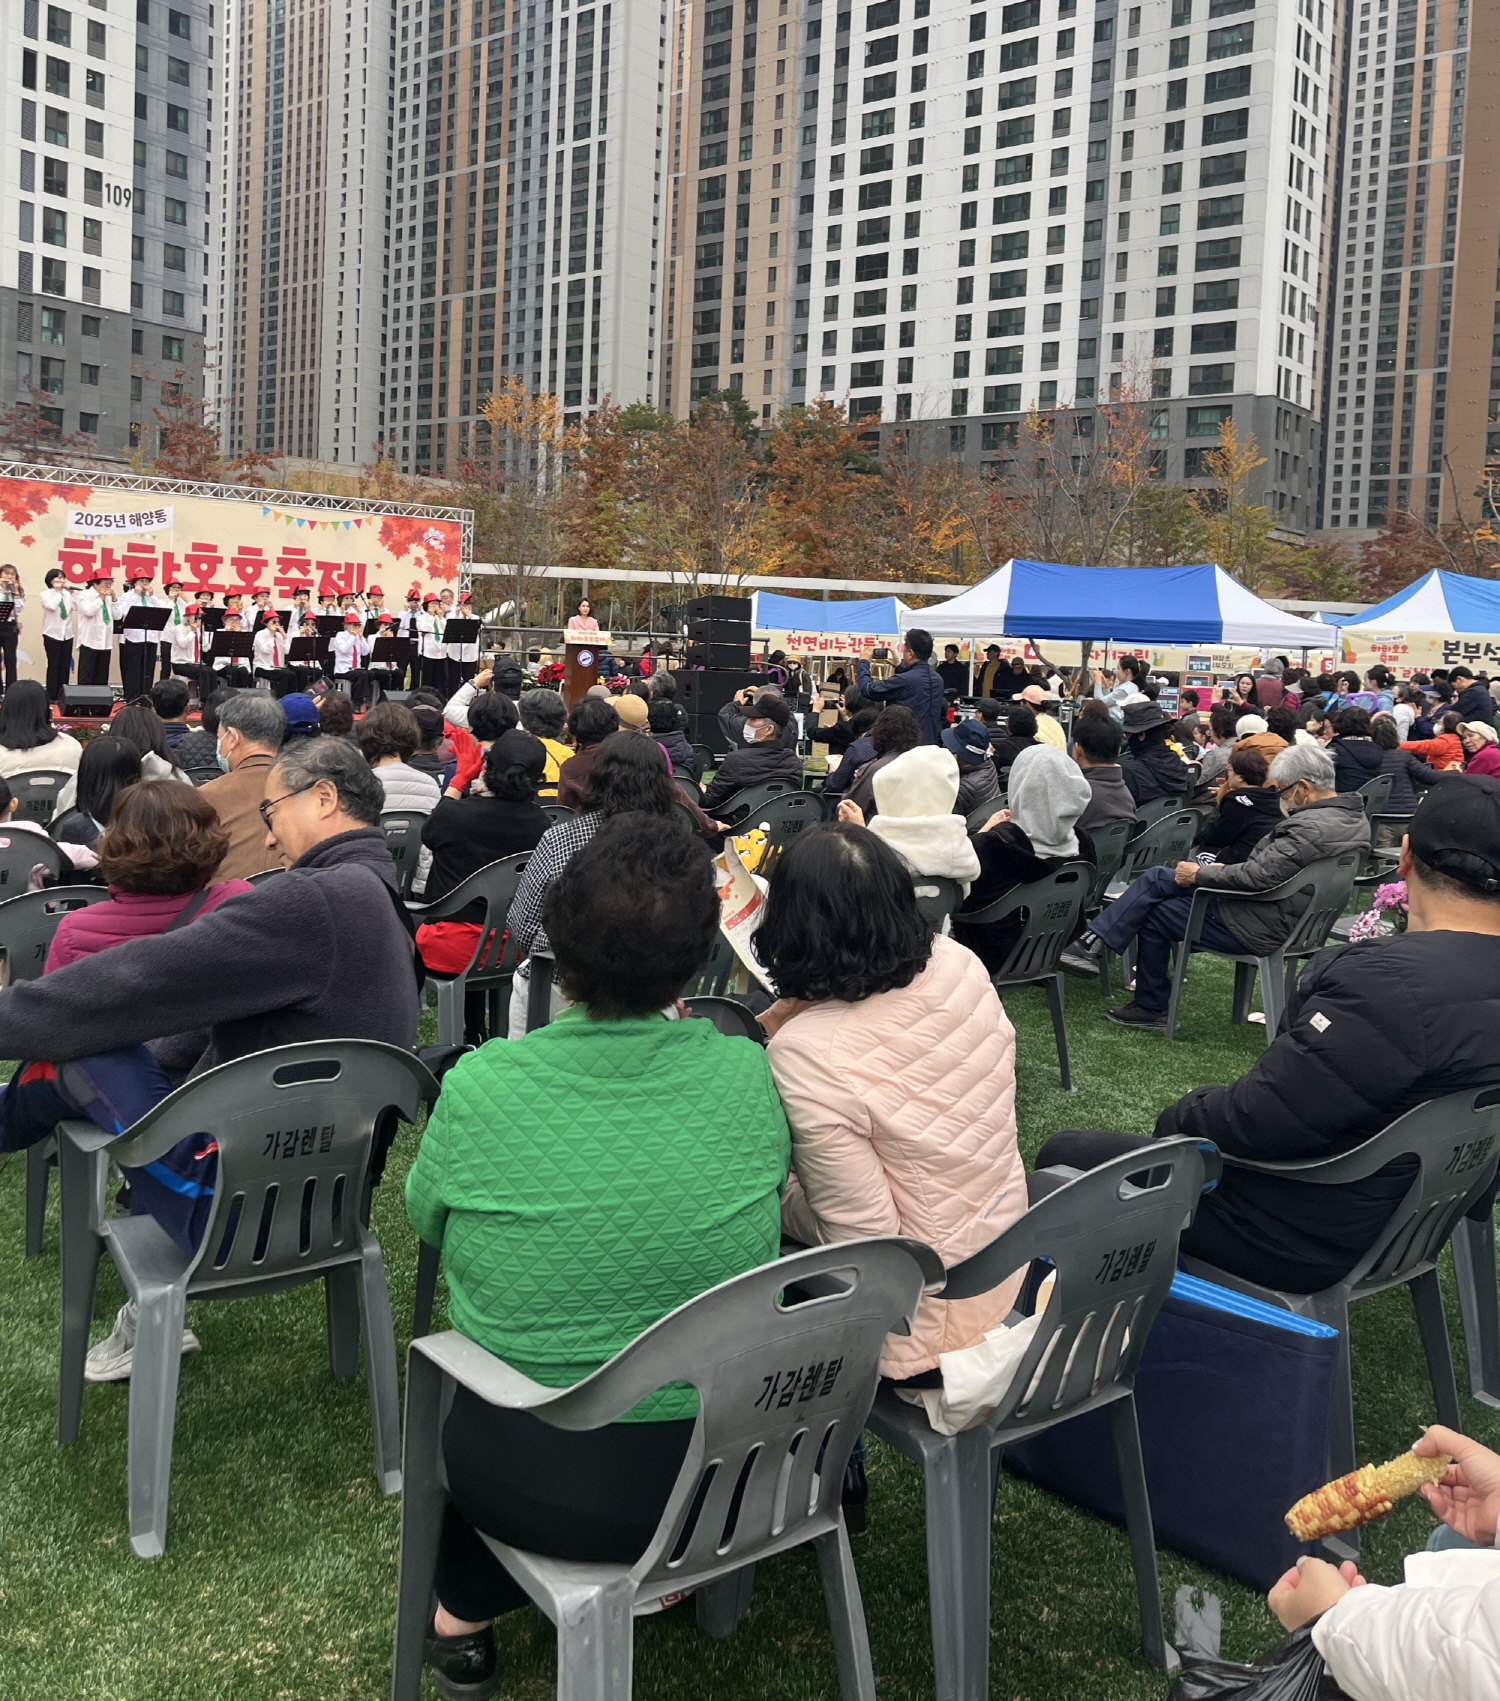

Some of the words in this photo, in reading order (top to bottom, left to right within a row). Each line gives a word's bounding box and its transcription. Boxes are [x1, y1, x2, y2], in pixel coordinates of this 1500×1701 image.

[105, 183, 132, 208] 109
[74, 512, 126, 528] 2025년
[129, 509, 167, 526] 해양동
[1370, 644, 1409, 654] 하하호호
[1380, 652, 1399, 664] 축제
[1325, 660, 1333, 671] 5
[262, 1123, 336, 1161] 가감렌탈
[1095, 1238, 1158, 1285] 가감렌탈
[754, 1356, 844, 1412] 가감렌탈
